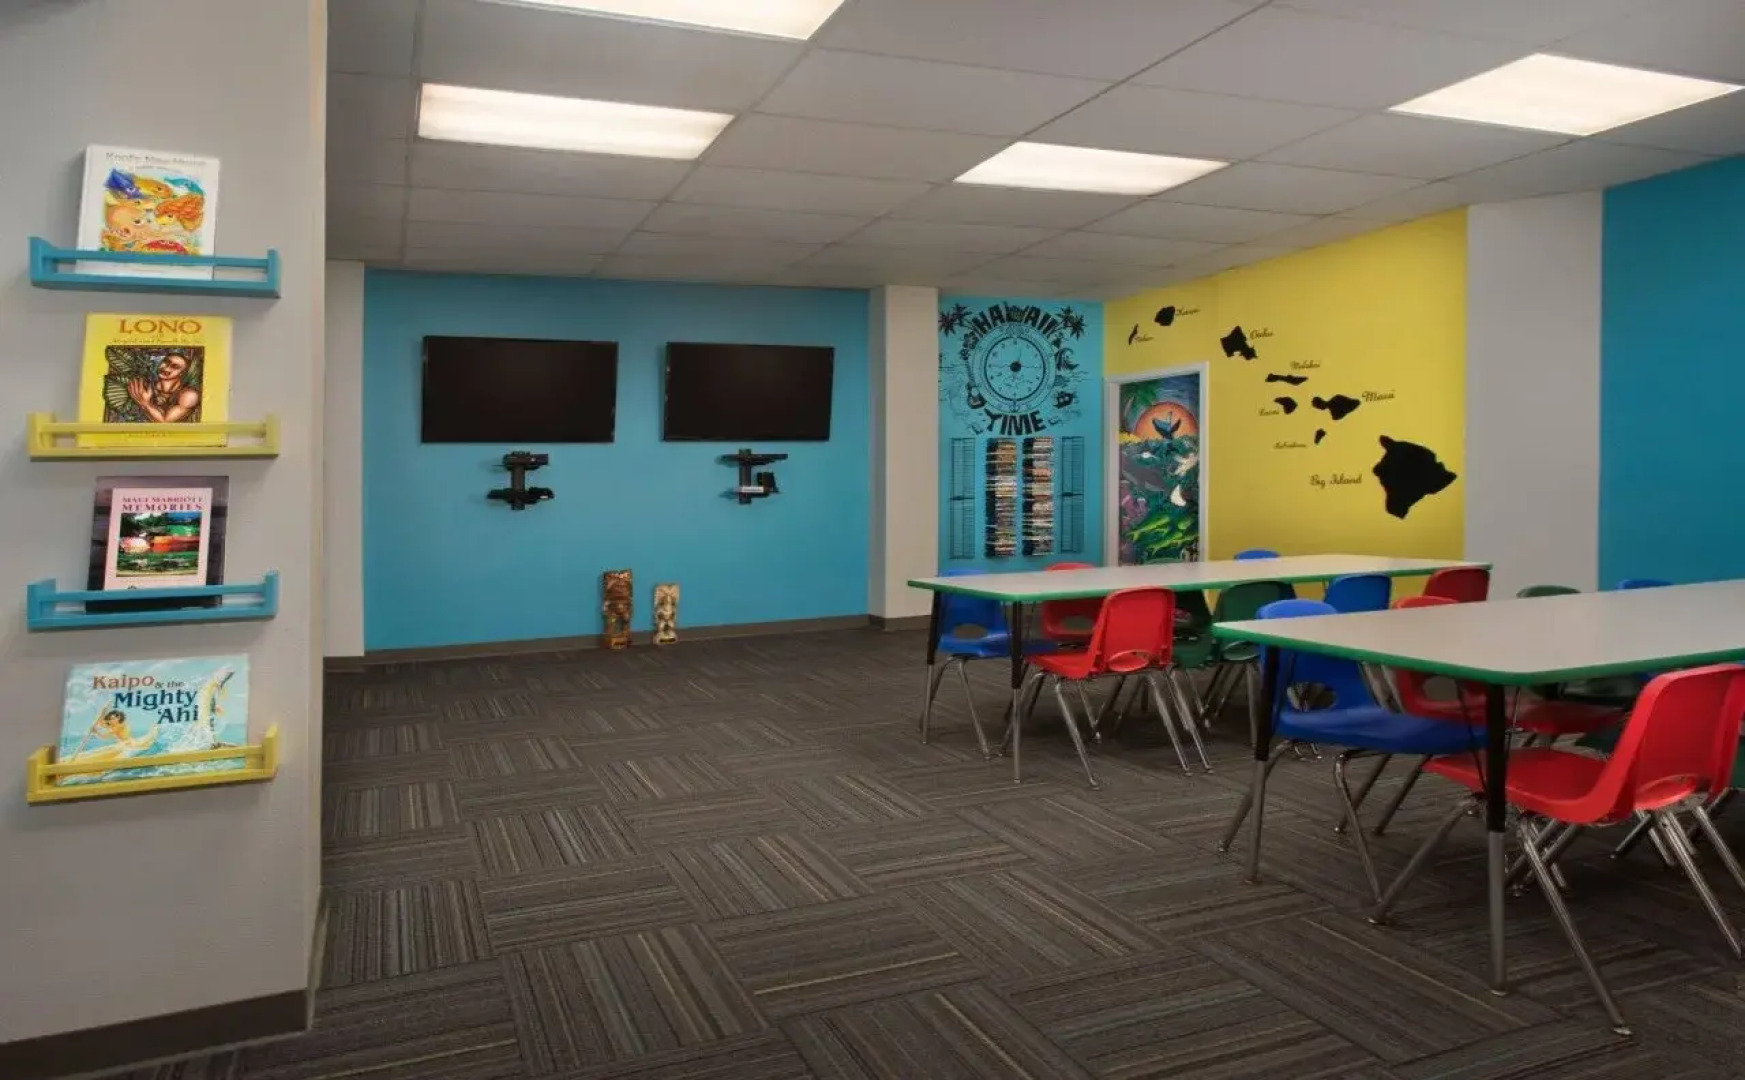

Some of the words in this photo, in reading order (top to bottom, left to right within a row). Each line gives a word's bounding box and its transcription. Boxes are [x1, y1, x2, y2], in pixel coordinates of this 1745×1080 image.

[119, 318, 202, 334] LONO
[1361, 389, 1396, 402] Maui
[984, 408, 1047, 436] TIME
[1329, 472, 1363, 485] Island
[92, 674, 155, 690] Kaipo
[154, 681, 165, 689] &
[167, 680, 185, 688] the
[113, 689, 198, 711] Mighty
